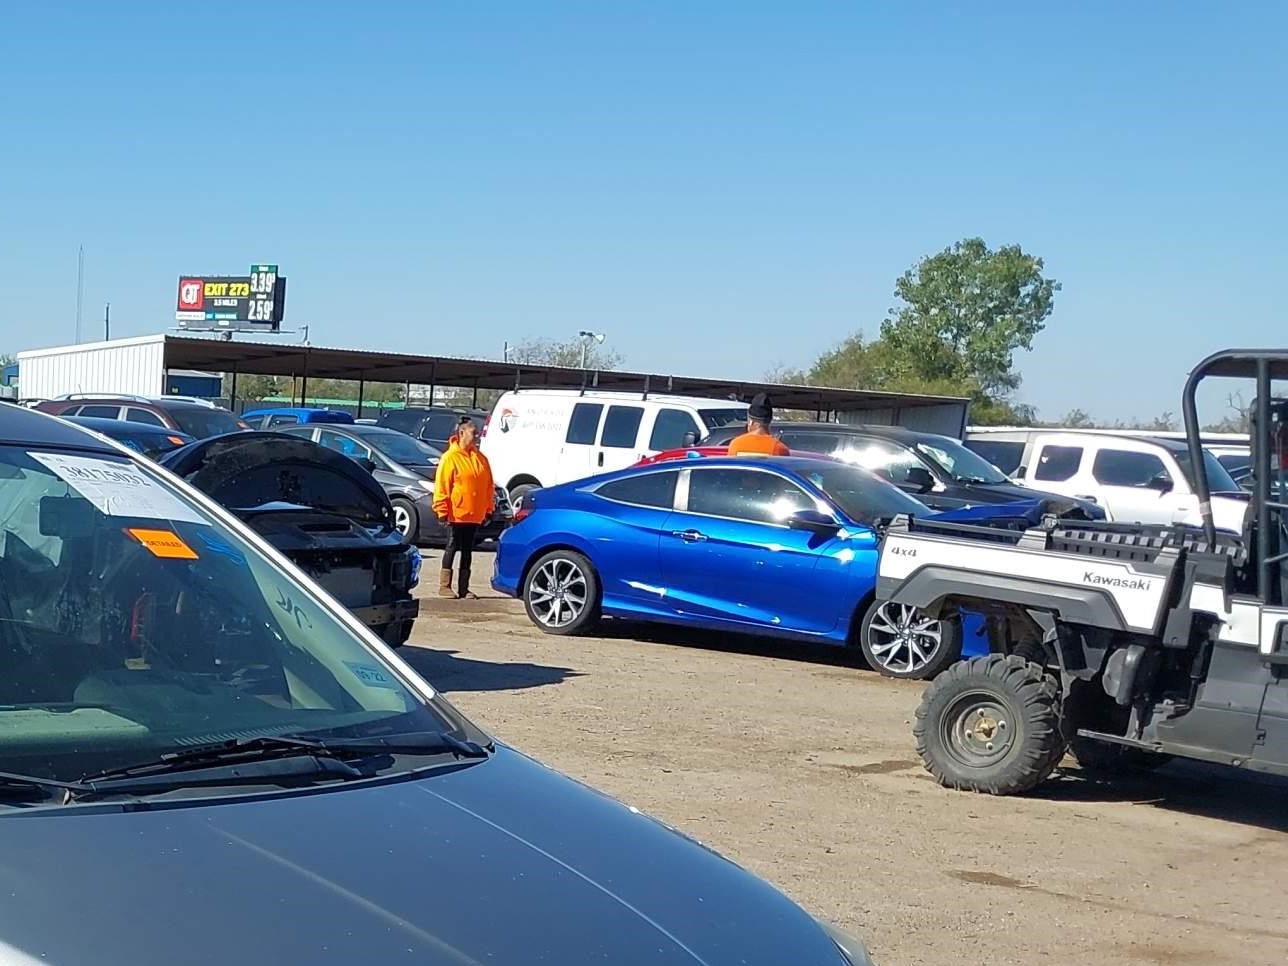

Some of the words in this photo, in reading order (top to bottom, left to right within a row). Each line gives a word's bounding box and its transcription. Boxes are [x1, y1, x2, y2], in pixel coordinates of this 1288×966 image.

[182, 284, 200, 304] QT
[204, 283, 228, 296] EXIT
[229, 283, 250, 297] 273
[60, 464, 152, 489] 38175032
[890, 545, 918, 558] 4x4
[1082, 570, 1152, 592] Kawasaki
